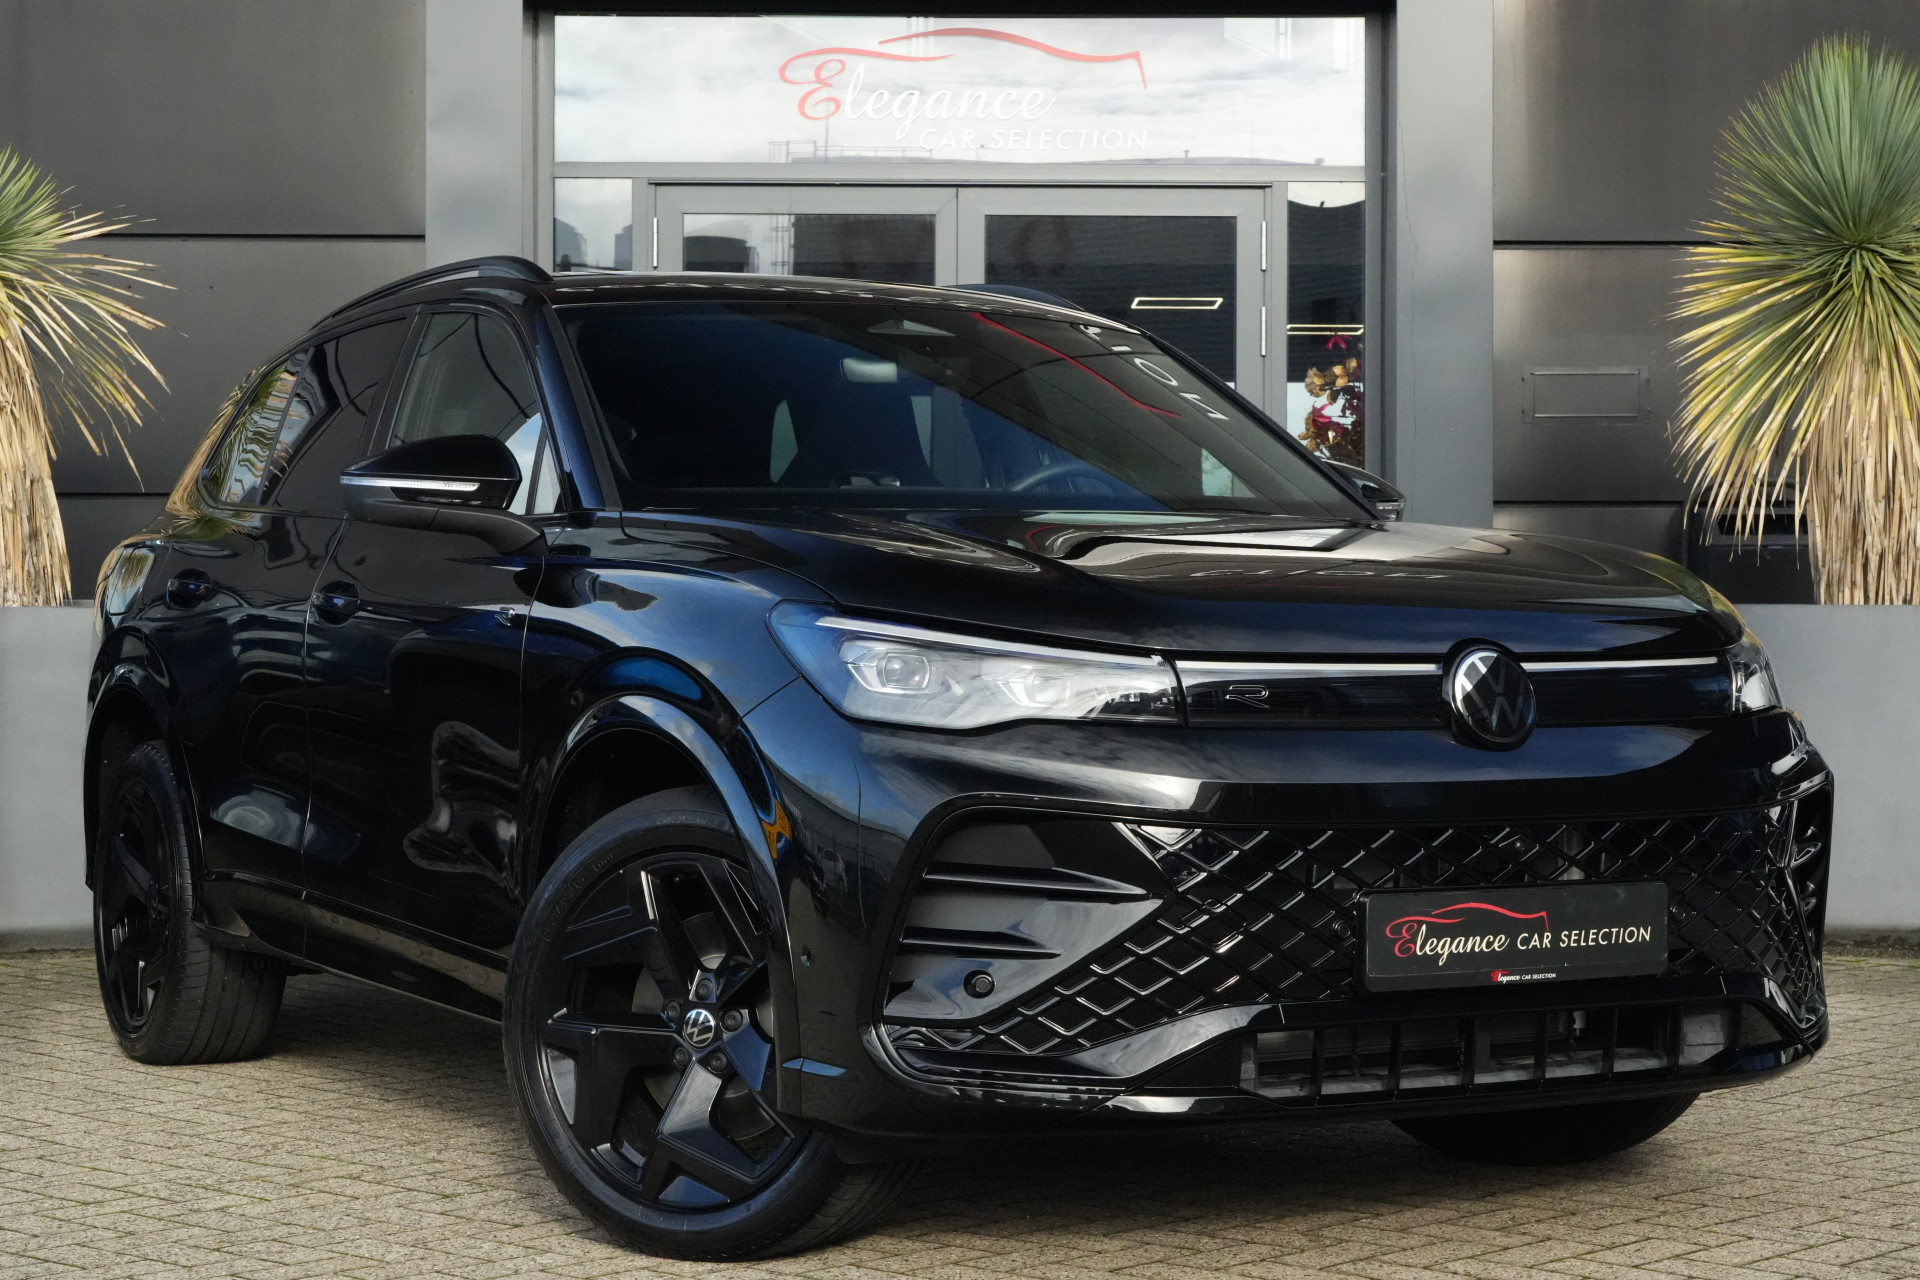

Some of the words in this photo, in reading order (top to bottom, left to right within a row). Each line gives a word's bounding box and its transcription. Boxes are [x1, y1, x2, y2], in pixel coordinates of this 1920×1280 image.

[778, 47, 1056, 141] Elegance
[919, 128, 976, 151] CAR
[990, 128, 1148, 151] SELECTION
[1385, 916, 1511, 966] Elegance
[1517, 931, 1552, 950] CAR
[1559, 925, 1652, 949] SELECTION
[1491, 970, 1520, 984] Elegance
